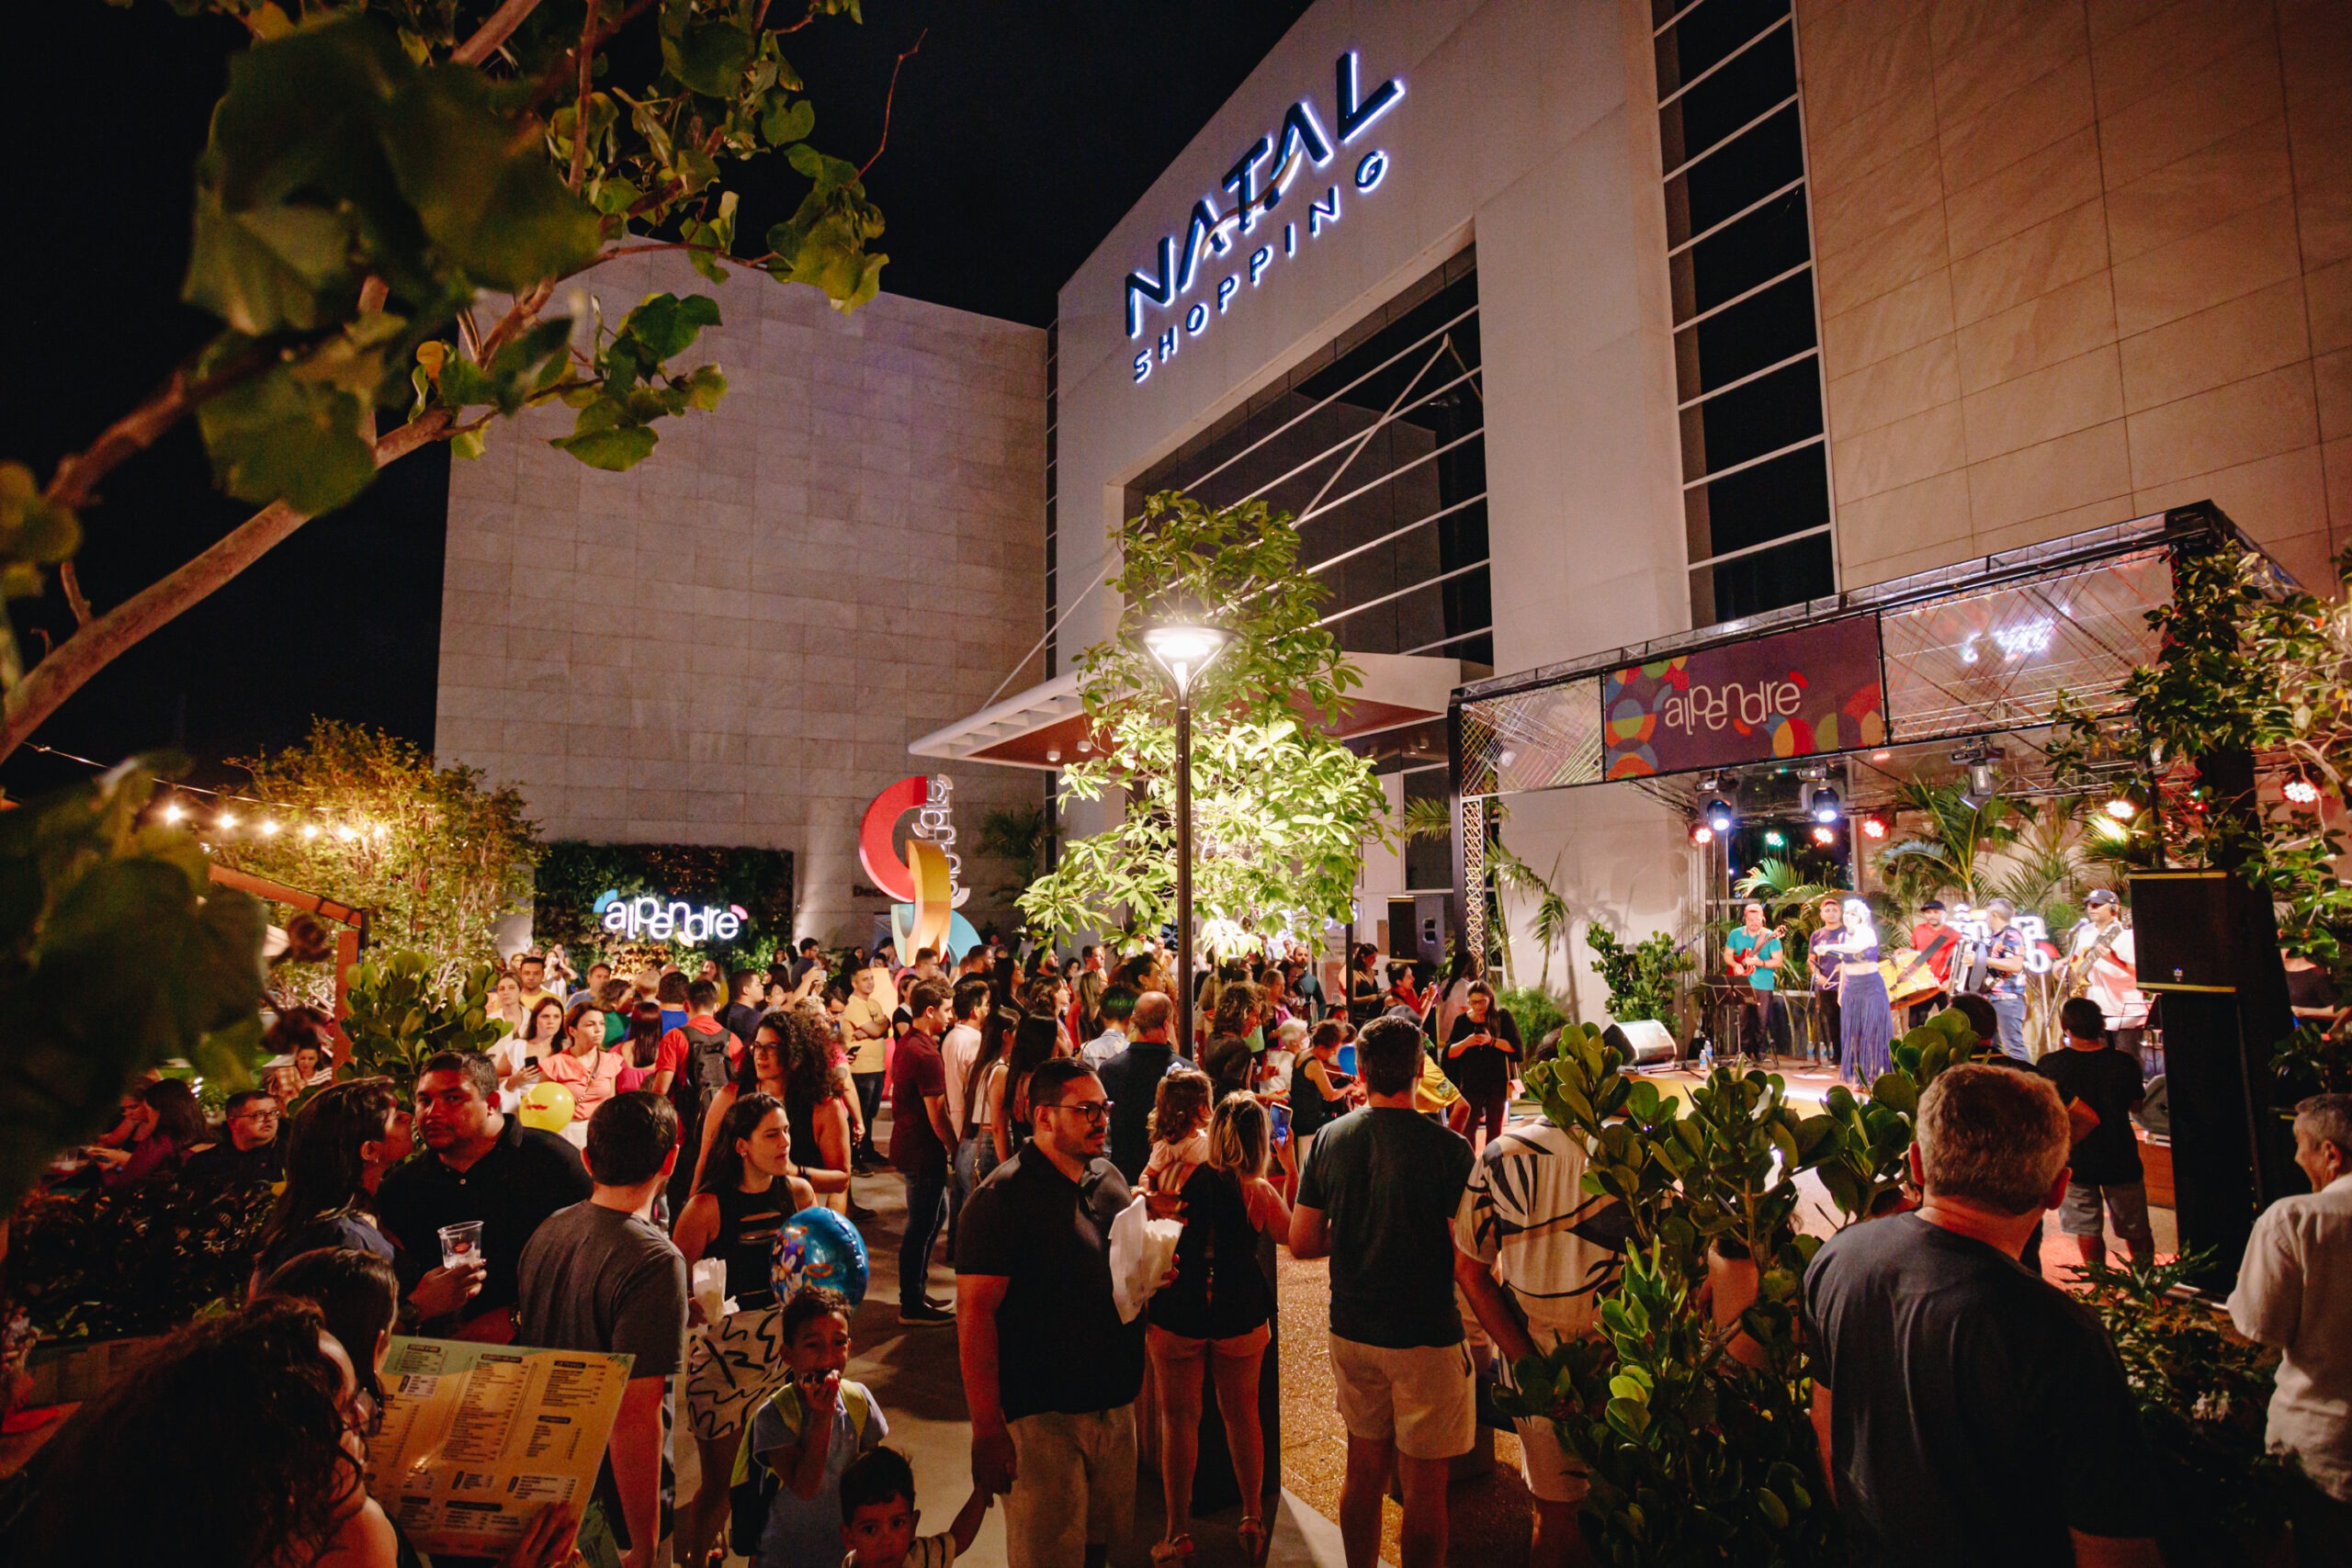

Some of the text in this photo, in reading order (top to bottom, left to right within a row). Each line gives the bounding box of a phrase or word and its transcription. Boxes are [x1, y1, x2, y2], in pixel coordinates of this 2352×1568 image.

[1125, 51, 1406, 339] NATAL
[1133, 149, 1389, 384] SHOPPING
[1664, 680, 1802, 736] alpendre
[604, 897, 741, 942] alpendre
